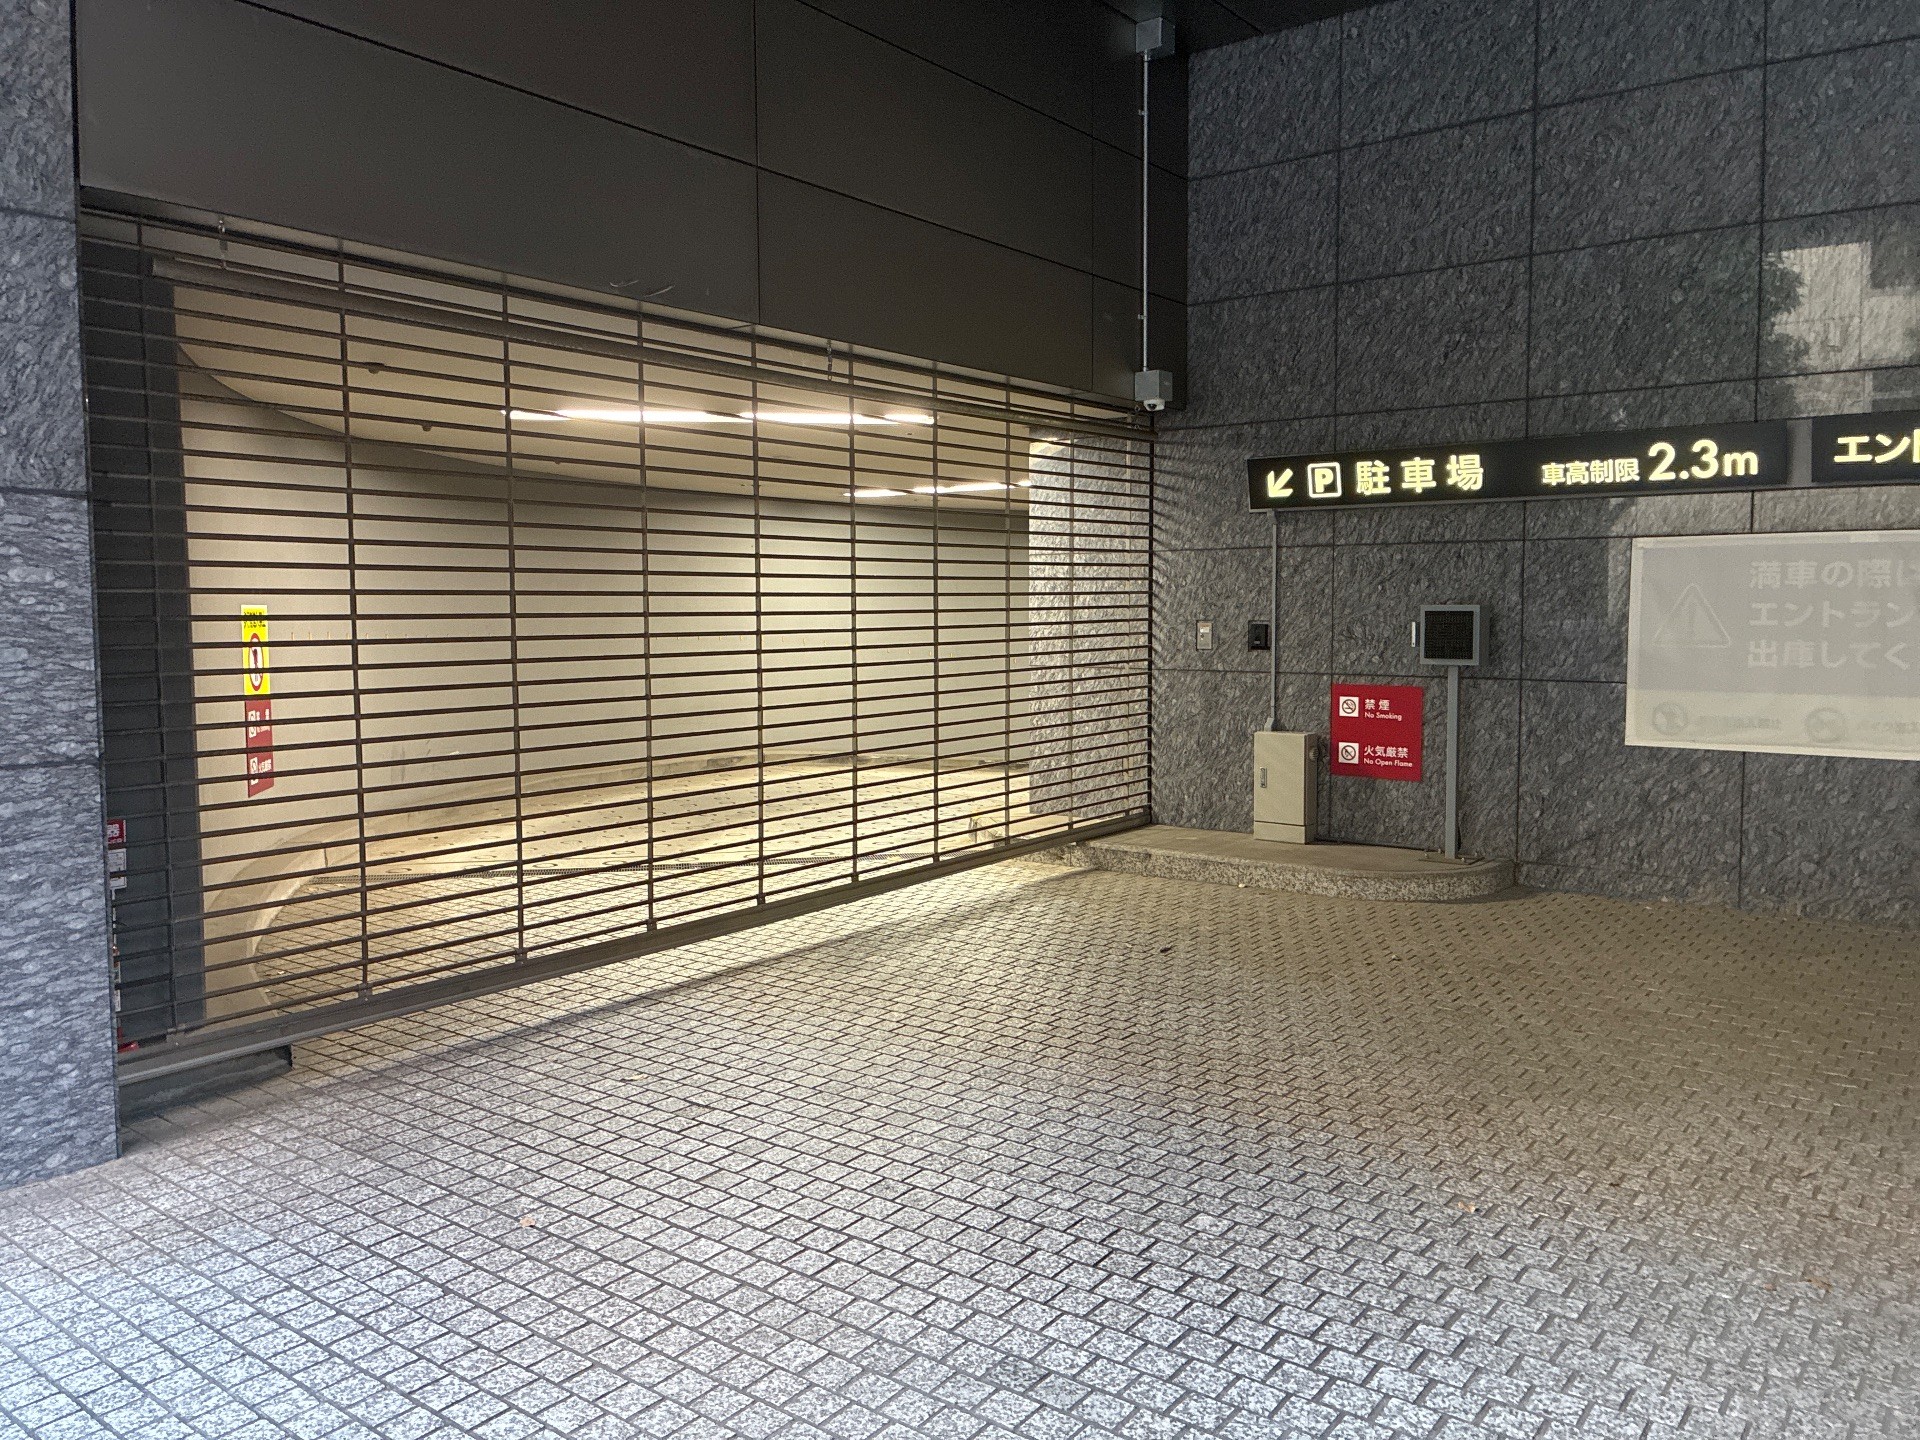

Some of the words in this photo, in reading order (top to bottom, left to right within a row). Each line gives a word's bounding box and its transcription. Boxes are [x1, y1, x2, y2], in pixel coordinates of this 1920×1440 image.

[1356, 454, 1484, 496] 駐車場
[1541, 458, 1640, 486] 車高制限
[1648, 439, 1759, 481] 2.3m
[1749, 601, 1916, 628] エントラン
[1748, 639, 1911, 670] 出庫してく
[1364, 698, 1390, 711] 禁煙
[1364, 711, 1374, 719] No
[1376, 711, 1402, 722] Smoking
[1364, 745, 1408, 758] 火気厳禁
[1375, 758, 1393, 767] Open
